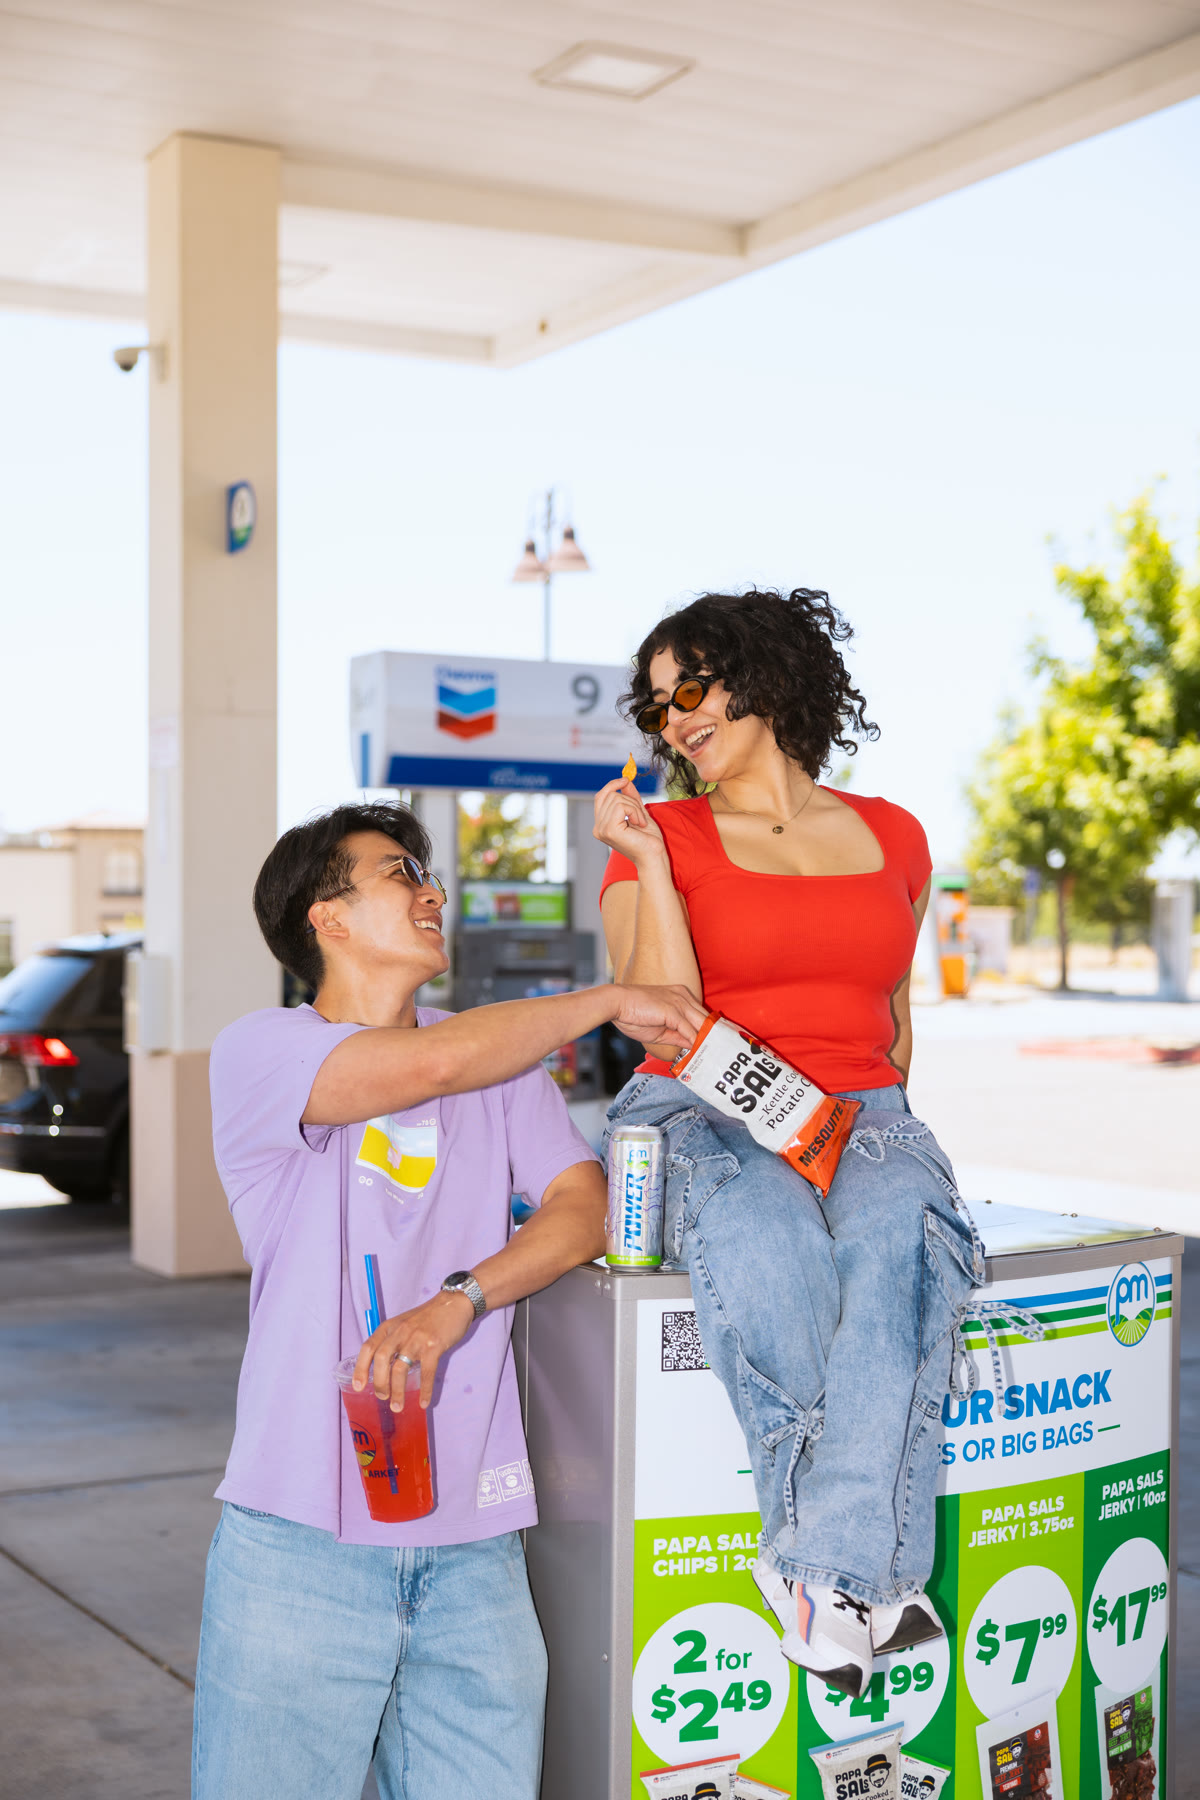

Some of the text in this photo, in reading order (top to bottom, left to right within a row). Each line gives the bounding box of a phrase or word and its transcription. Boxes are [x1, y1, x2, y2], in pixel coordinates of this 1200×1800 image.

[570, 673, 600, 715] 9
[714, 1052, 751, 1095] PAPA
[762, 1069, 799, 1116] Kettle Coo
[766, 1088, 805, 1131] Potato
[798, 1102, 843, 1167] MESQUITE
[623, 1172, 647, 1252] POWER
[1002, 1369, 1112, 1421] SNACK
[963, 1437, 995, 1462] OR
[1001, 1431, 1037, 1457] BIG
[1042, 1420, 1094, 1450] BAGS
[1098, 1498, 1135, 1521] JERKY
[1142, 1490, 1166, 1508] 10oz
[1102, 1470, 1164, 1501] PAPA SALS
[968, 1524, 1018, 1548] JERKY
[1029, 1515, 1074, 1537] 3.75oz
[981, 1496, 1064, 1525] PAPA SALS
[652, 1556, 718, 1577] CHIPS
[733, 1554, 757, 1572] 2o
[653, 1535, 712, 1556] PAPA
[672, 1629, 752, 1674] 2 for
[835, 1768, 861, 1784] PAPA
[903, 1773, 919, 1784] PAPA
